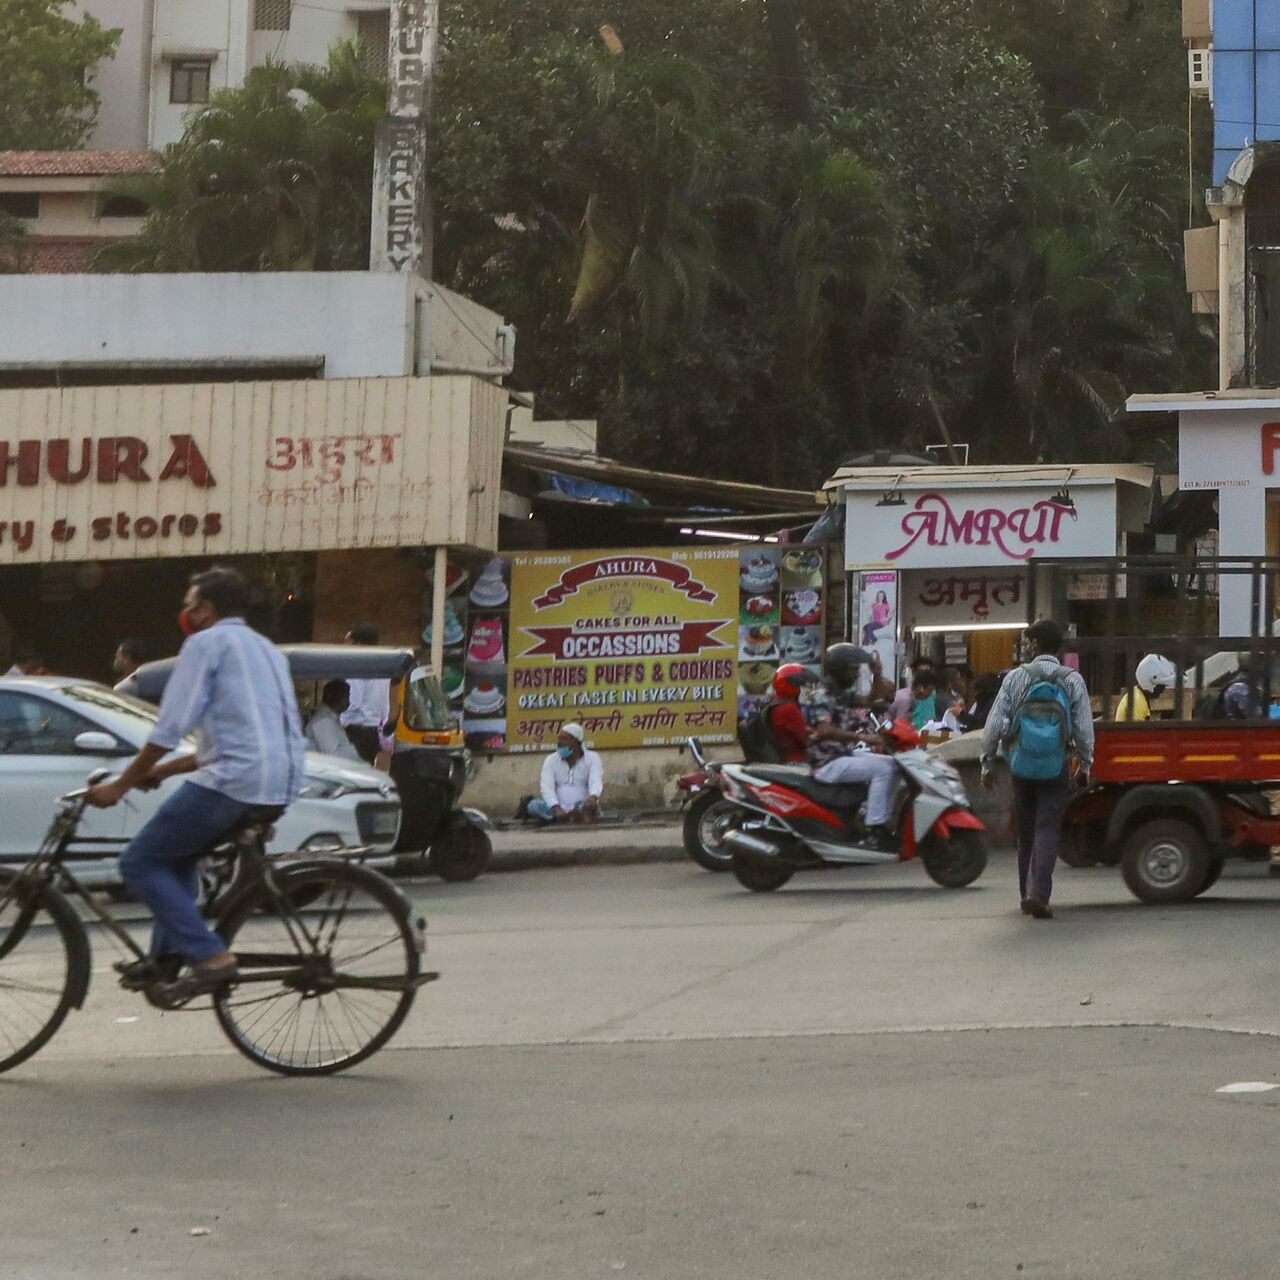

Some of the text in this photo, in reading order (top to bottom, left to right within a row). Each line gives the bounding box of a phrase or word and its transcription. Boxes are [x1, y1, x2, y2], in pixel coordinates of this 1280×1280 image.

[0, 433, 217, 488] HURA
[50, 519, 76, 544] &
[91, 511, 223, 541] stores
[884, 492, 1079, 561] AMRUT
[594, 560, 659, 578] AHURA
[919, 574, 1027, 618] अमृत
[576, 614, 680, 629] CAKES FOR ALL
[562, 632, 681, 658] OCCASSIONS
[513, 659, 733, 690] PASTRIES PUFFS & COOKIES
[518, 684, 725, 710] GREAT TASTE IN EVERY BITE
[576, 709, 625, 734] ेकरी
[630, 706, 679, 731] आणि
